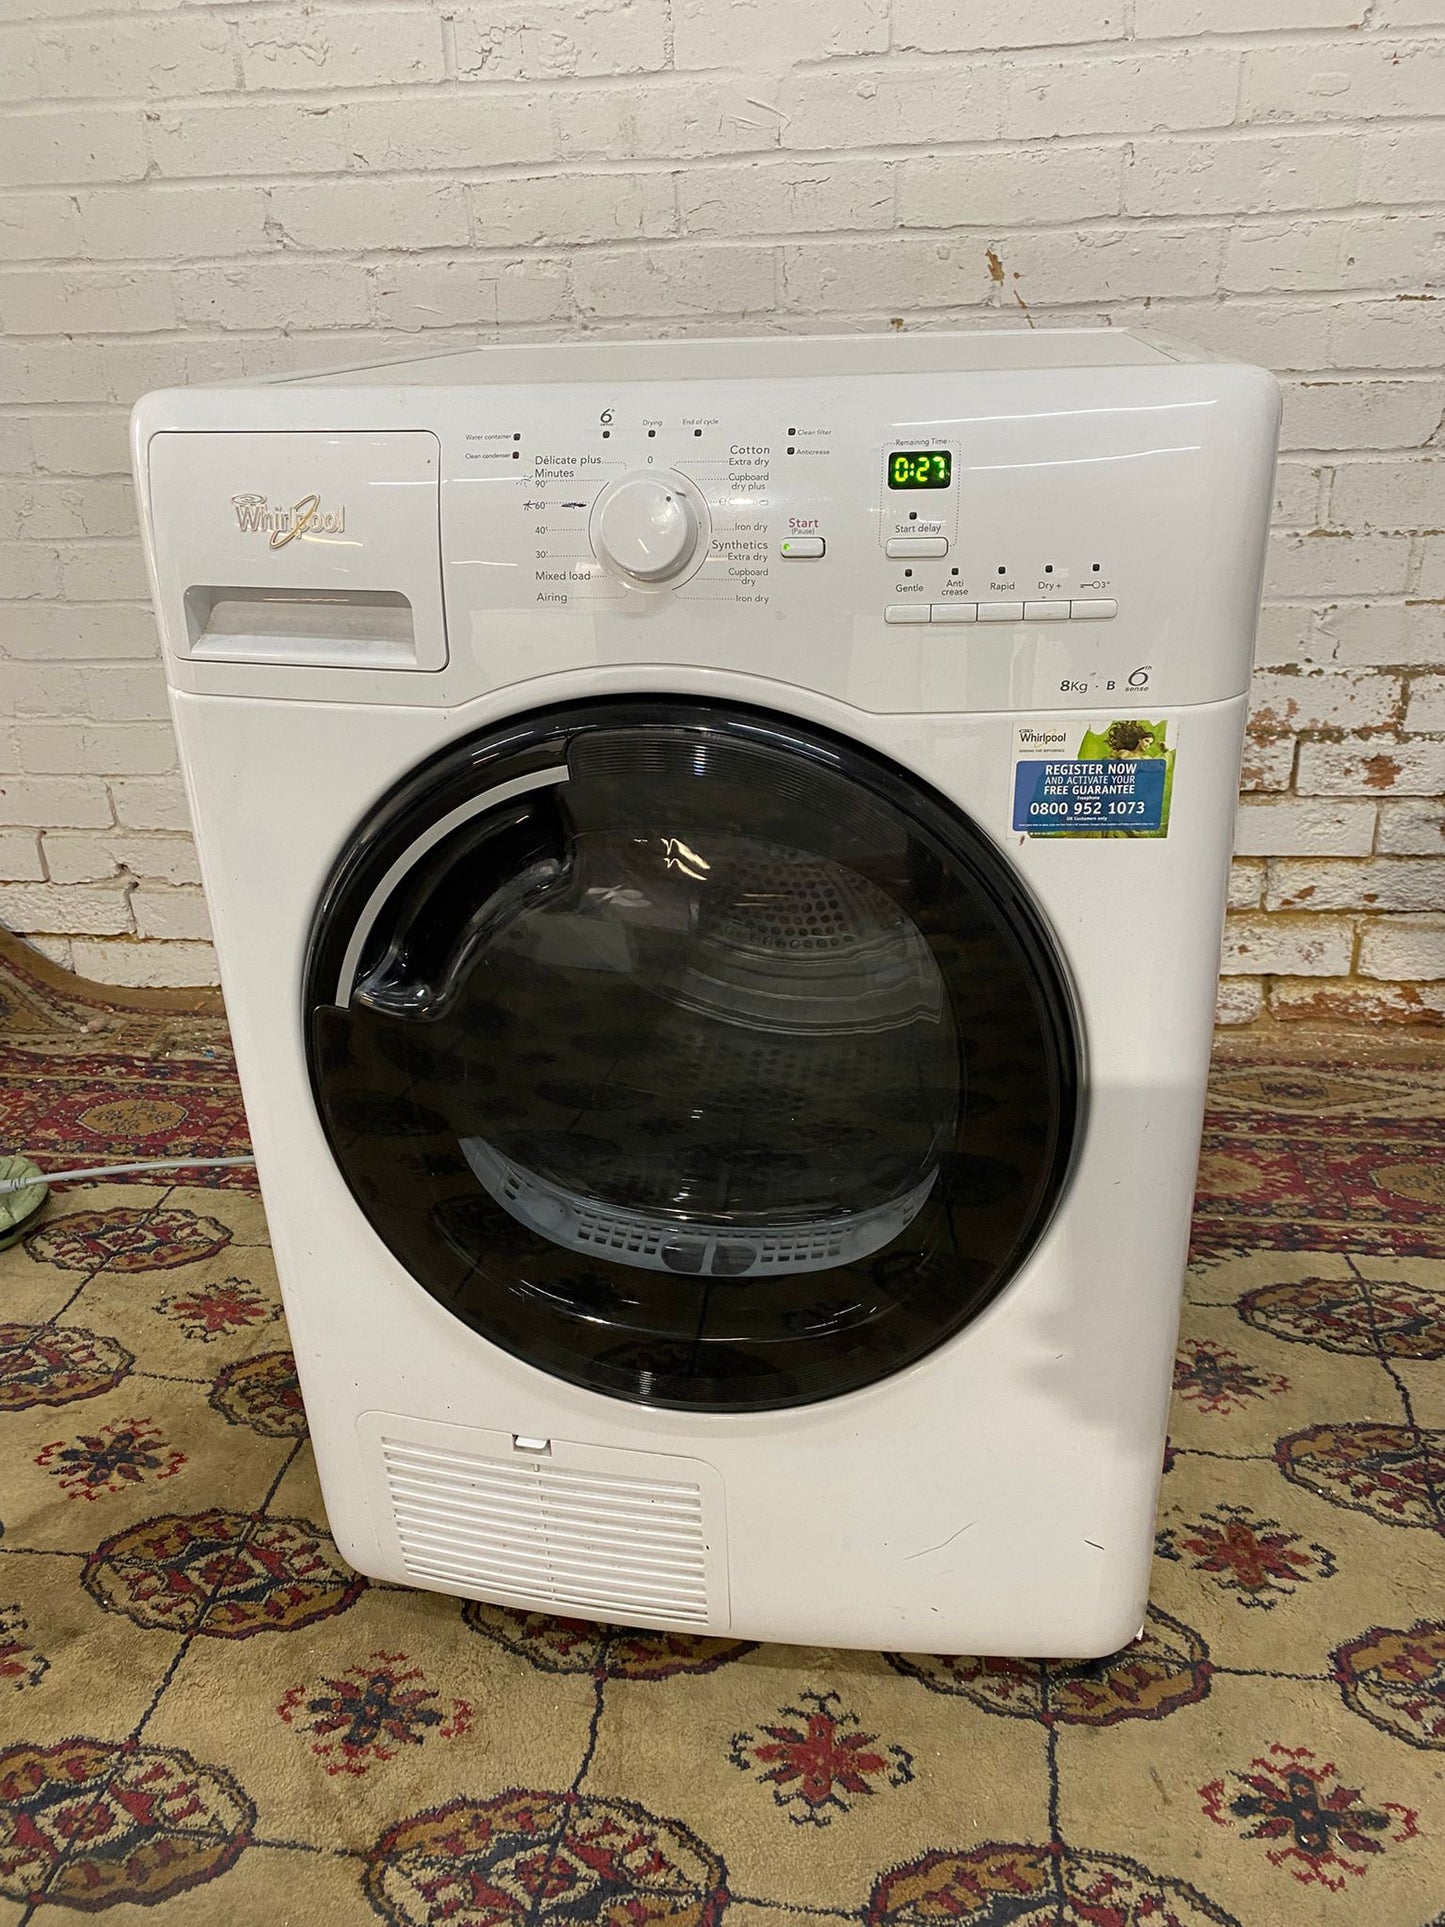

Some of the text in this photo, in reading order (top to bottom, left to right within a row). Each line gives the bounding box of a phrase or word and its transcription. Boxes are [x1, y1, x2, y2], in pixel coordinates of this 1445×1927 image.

[642, 419, 662, 427] Drying
[703, 417, 718, 426] cycle
[817, 428, 831, 436] filter
[895, 437, 947, 446] Remaining Time
[730, 444, 770, 455] Cotton
[535, 455, 601, 466] Délicate plus
[729, 457, 769, 467] Extra dry
[535, 468, 574, 478] Minutes
[894, 456, 946, 482] 0:27
[728, 473, 769, 483] Cupboard
[731, 482, 766, 492] dry plus
[235, 502, 345, 540] Whirlpool
[789, 517, 819, 528] Start
[754, 523, 768, 533] dry
[895, 524, 941, 534] Start delay
[712, 540, 768, 552] Synthetics
[728, 552, 768, 562] Extra dry
[535, 571, 591, 580] Mixed load
[728, 568, 769, 578] Cupboard
[741, 578, 756, 587] dry
[990, 582, 1015, 591] Rapid
[1038, 581, 1062, 590] Dry+
[895, 584, 924, 592] Gentle
[942, 588, 968, 596] crease
[536, 593, 568, 604] Airing
[735, 594, 769, 604] Iron dry
[1060, 680, 1116, 694] 8Kg B
[1020, 732, 1066, 744] Whirlpool
[1046, 763, 1137, 775] REGISTER NOW
[1045, 775, 1135, 785] AND ACTIVATE YOUR
[1044, 785, 1135, 795] FREE GUARANTEE
[1030, 802, 1145, 815] 0800 952 1073
